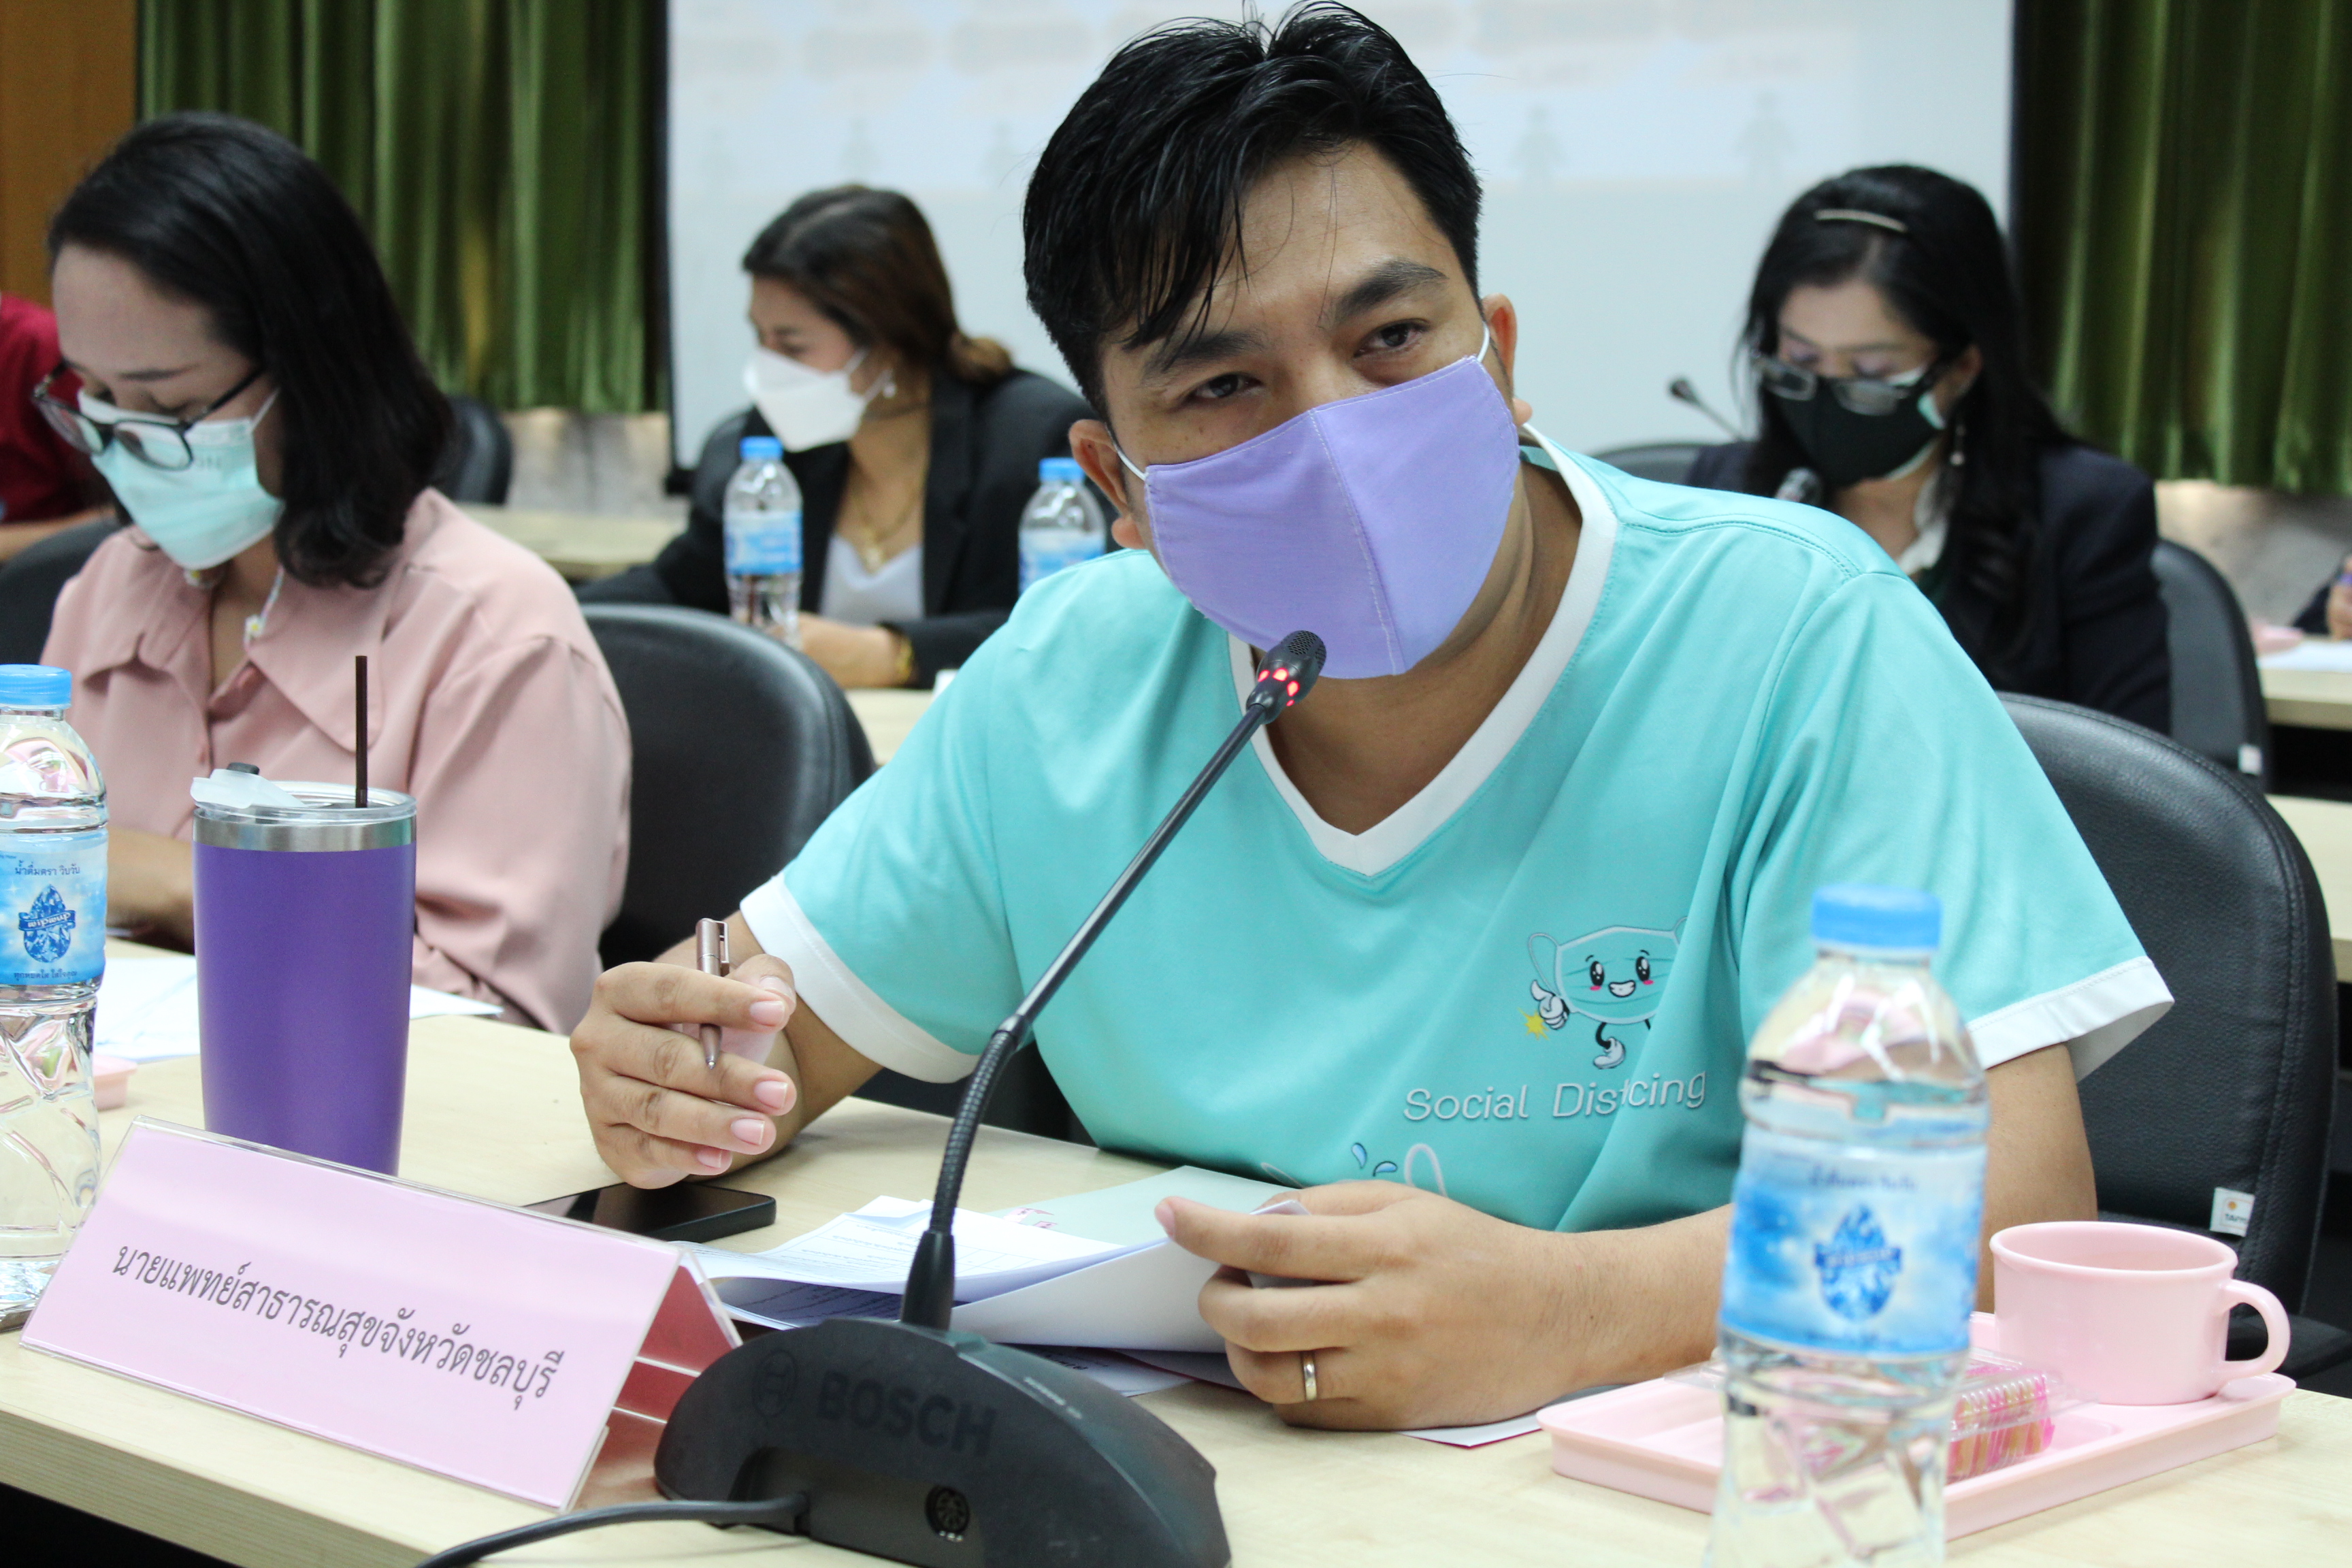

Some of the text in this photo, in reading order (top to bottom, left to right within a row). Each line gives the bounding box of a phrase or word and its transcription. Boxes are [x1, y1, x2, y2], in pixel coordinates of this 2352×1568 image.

[1403, 1083, 1529, 1122] Social
[112, 1245, 564, 1410] นายแพทย์สาธารณสุขจังหวัดชลบุรี
[816, 1369, 998, 1458] BOSCH
